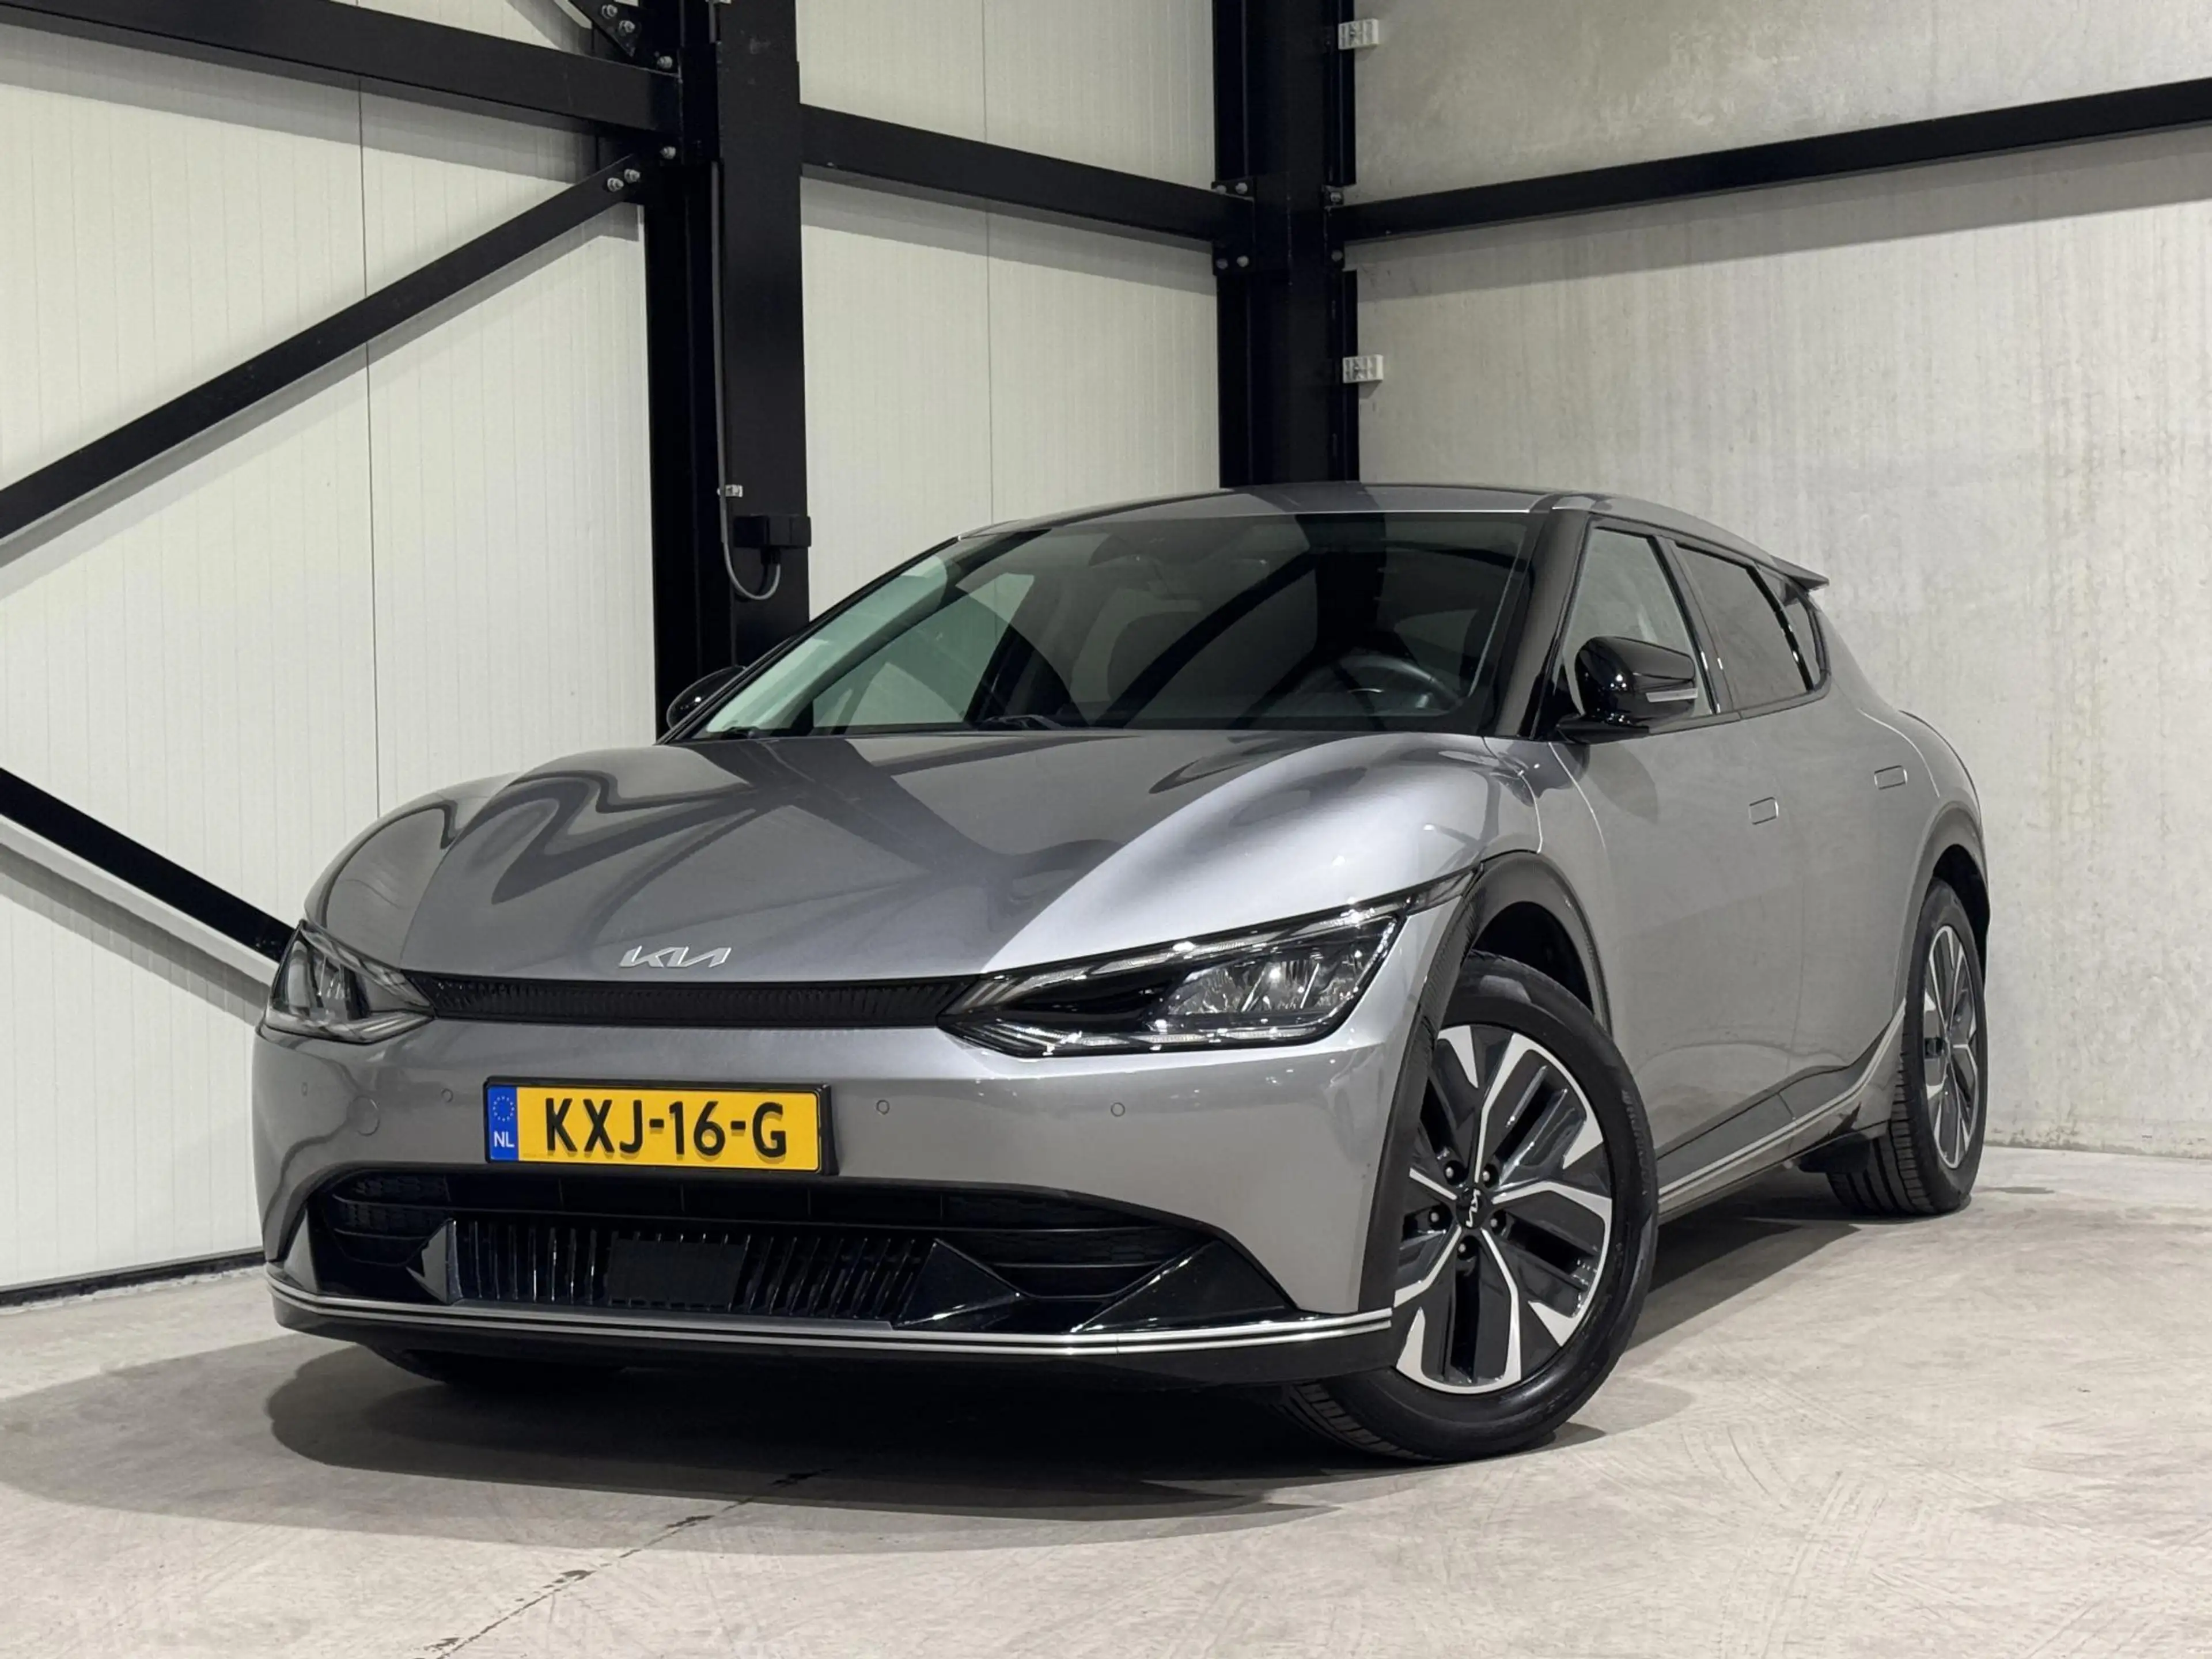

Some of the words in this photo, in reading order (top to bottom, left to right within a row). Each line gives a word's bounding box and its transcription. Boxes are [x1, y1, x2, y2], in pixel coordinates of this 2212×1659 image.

[619, 945, 732, 968] KIA
[494, 1130, 515, 1148] NL
[545, 1097, 787, 1158] KXJ-16-G
